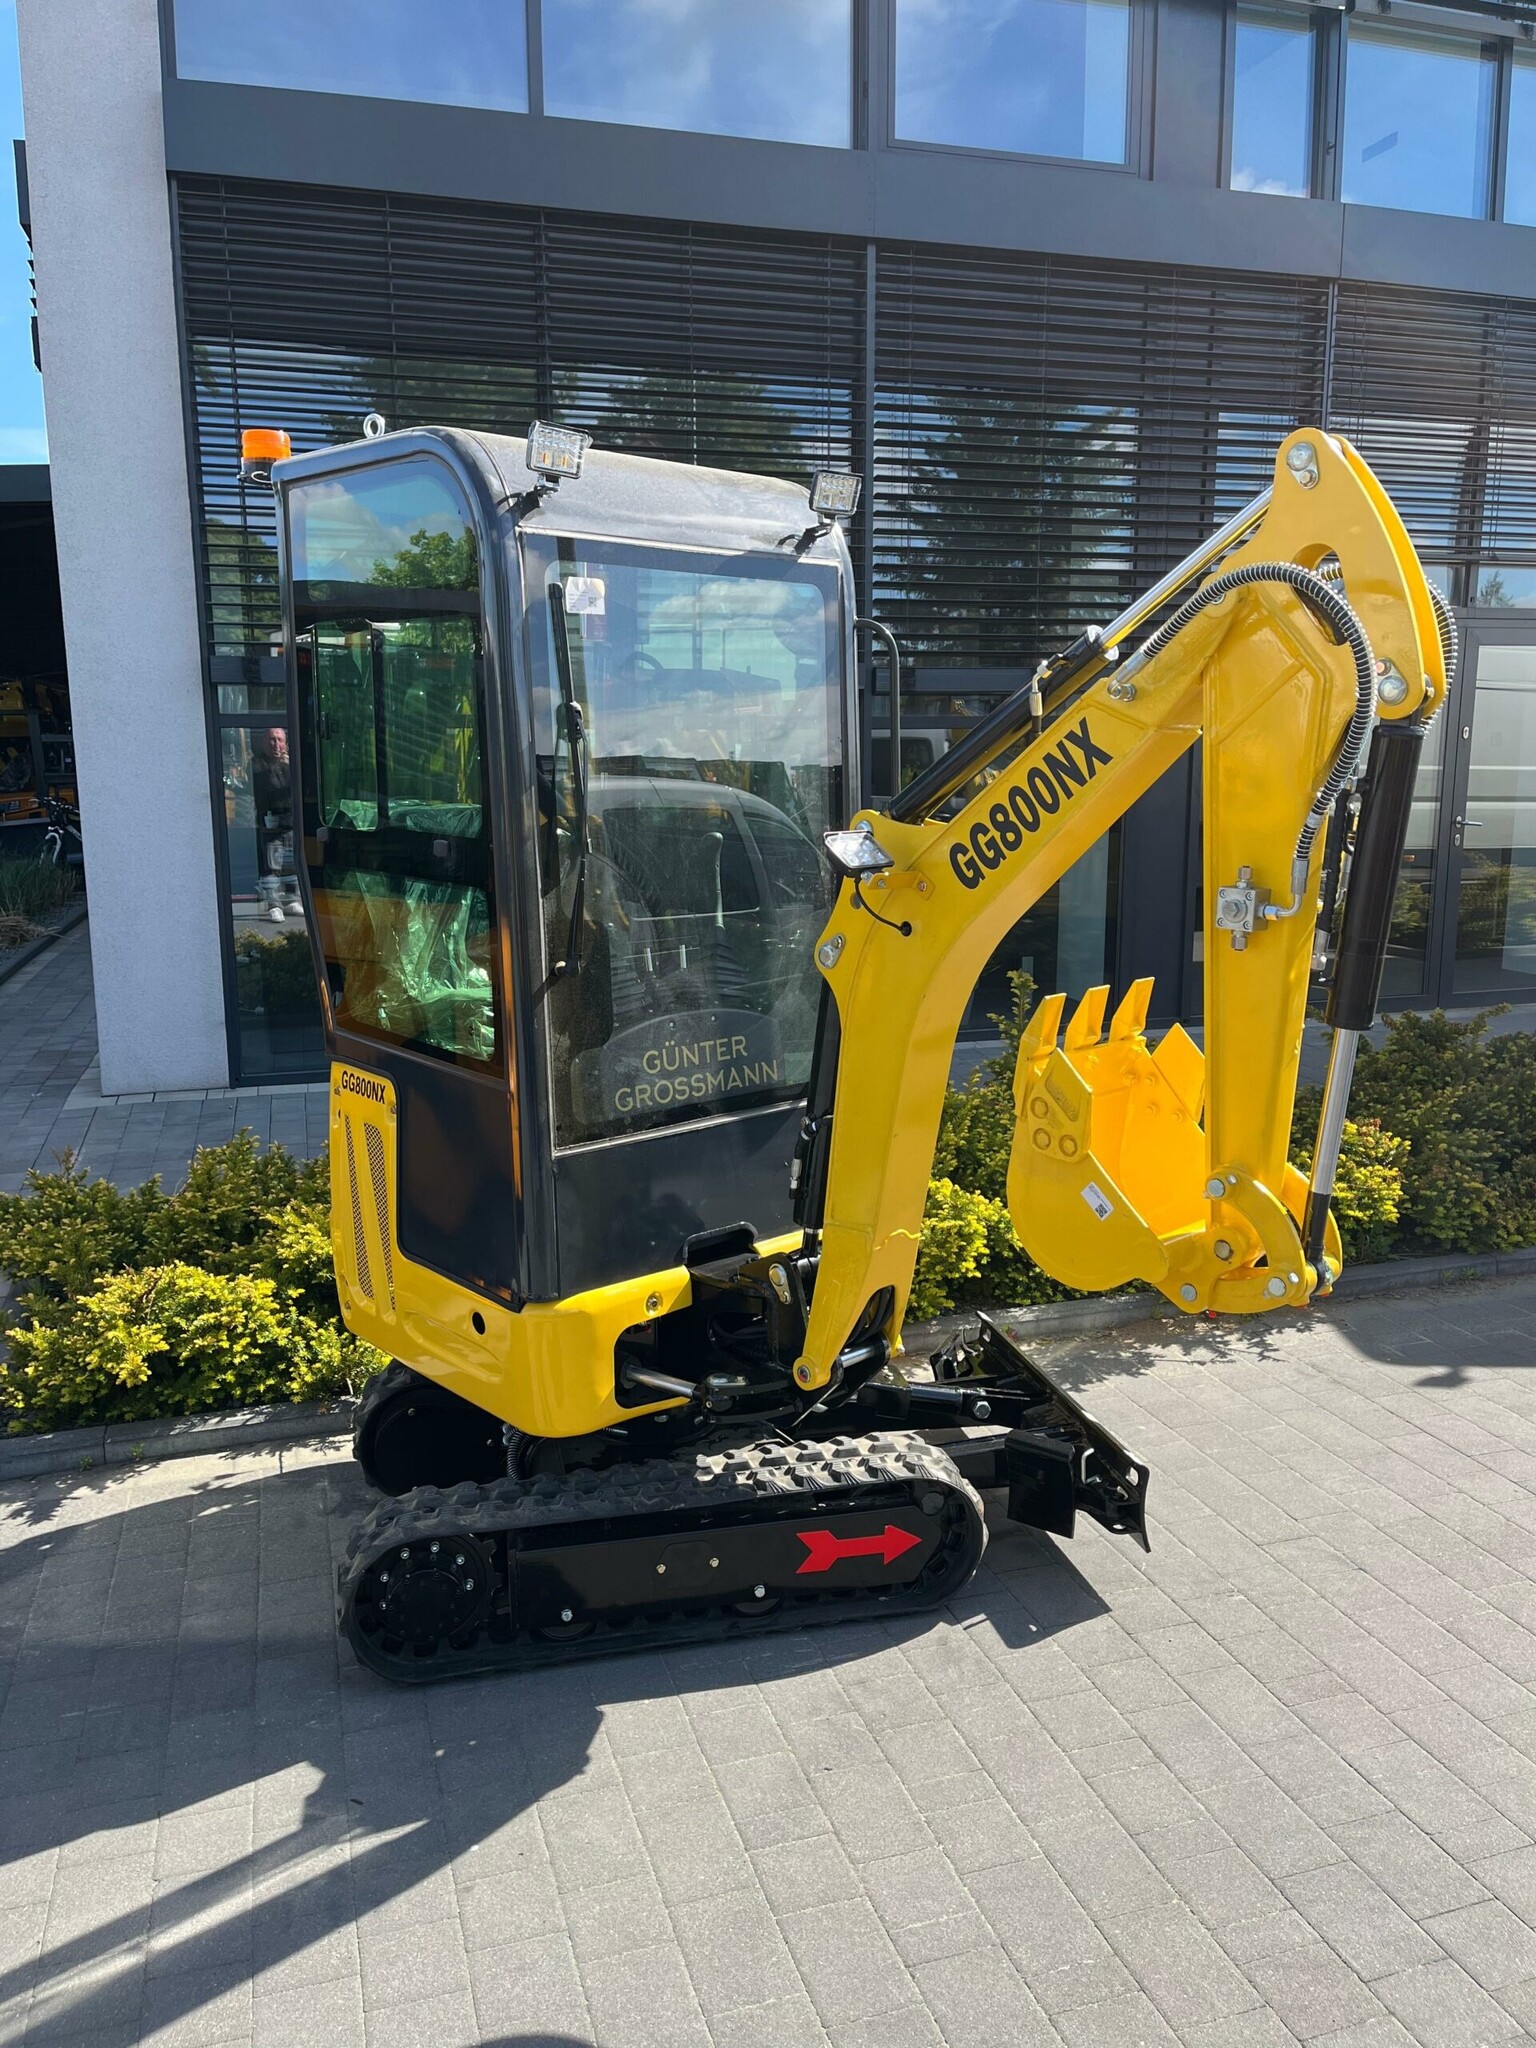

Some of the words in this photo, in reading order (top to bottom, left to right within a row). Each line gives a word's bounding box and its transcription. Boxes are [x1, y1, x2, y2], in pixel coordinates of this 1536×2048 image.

[949, 716, 1114, 890] GG800NX
[642, 1036, 748, 1074] GÜNTER
[341, 1070, 386, 1105] GG800NX
[615, 1060, 778, 1112] GROSSMANN
